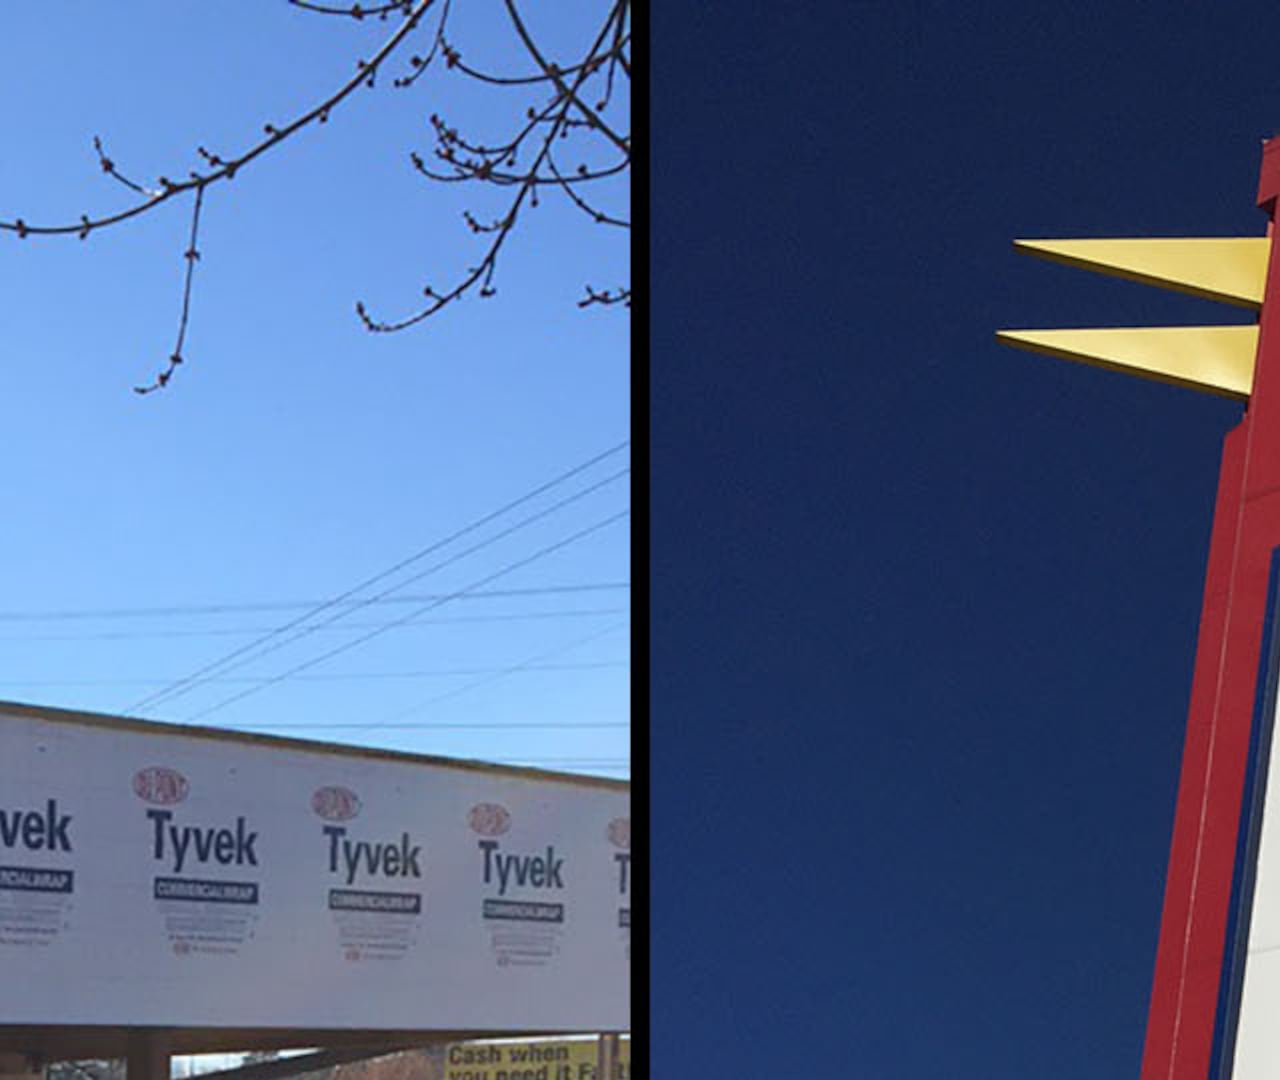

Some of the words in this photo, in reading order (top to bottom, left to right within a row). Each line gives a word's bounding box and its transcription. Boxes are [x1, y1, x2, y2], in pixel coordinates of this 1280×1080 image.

[146, 808, 259, 874] Tyvek
[322, 824, 422, 886] Tyvek
[478, 840, 564, 897] Tyvek
[449, 1046, 501, 1066] Cash
[510, 1045, 569, 1063] when
